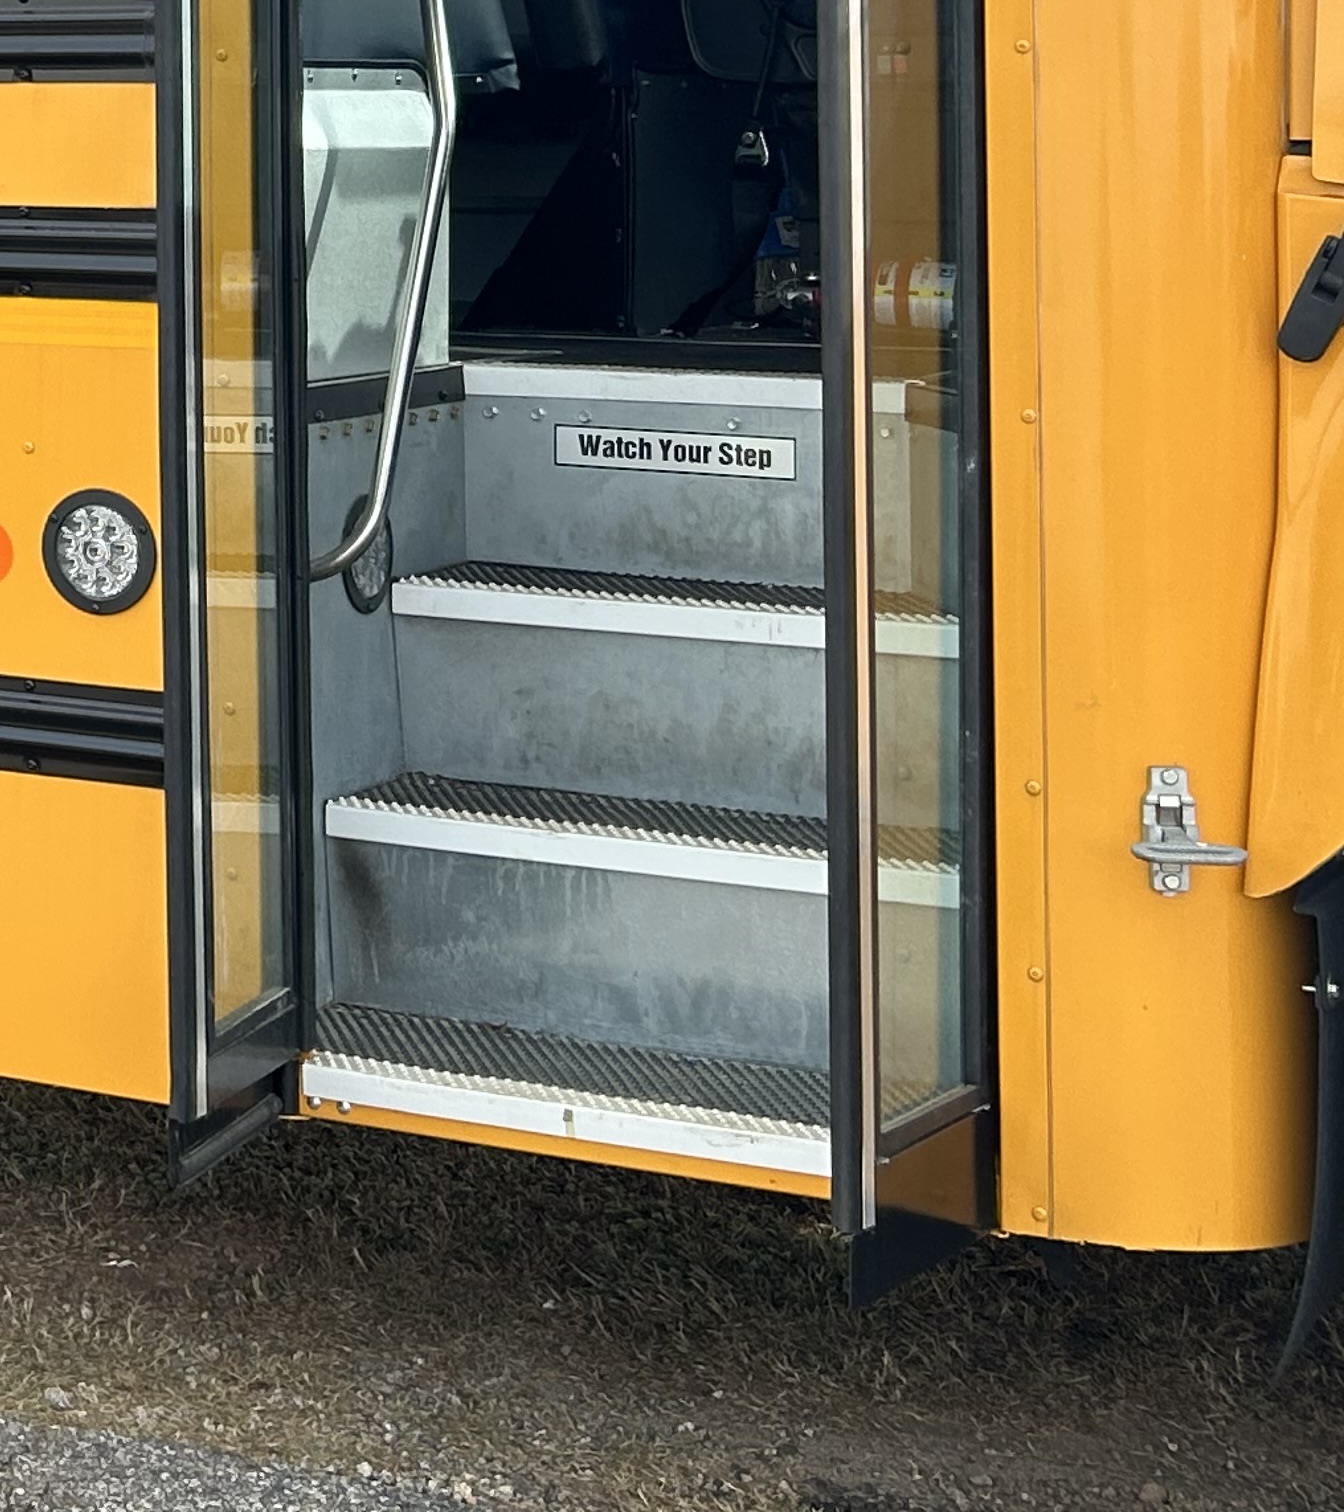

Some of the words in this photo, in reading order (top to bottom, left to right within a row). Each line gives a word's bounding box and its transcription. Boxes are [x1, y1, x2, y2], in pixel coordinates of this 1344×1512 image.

[578, 433, 653, 460] Watch
[659, 439, 712, 464] Your
[718, 442, 772, 470] Step
